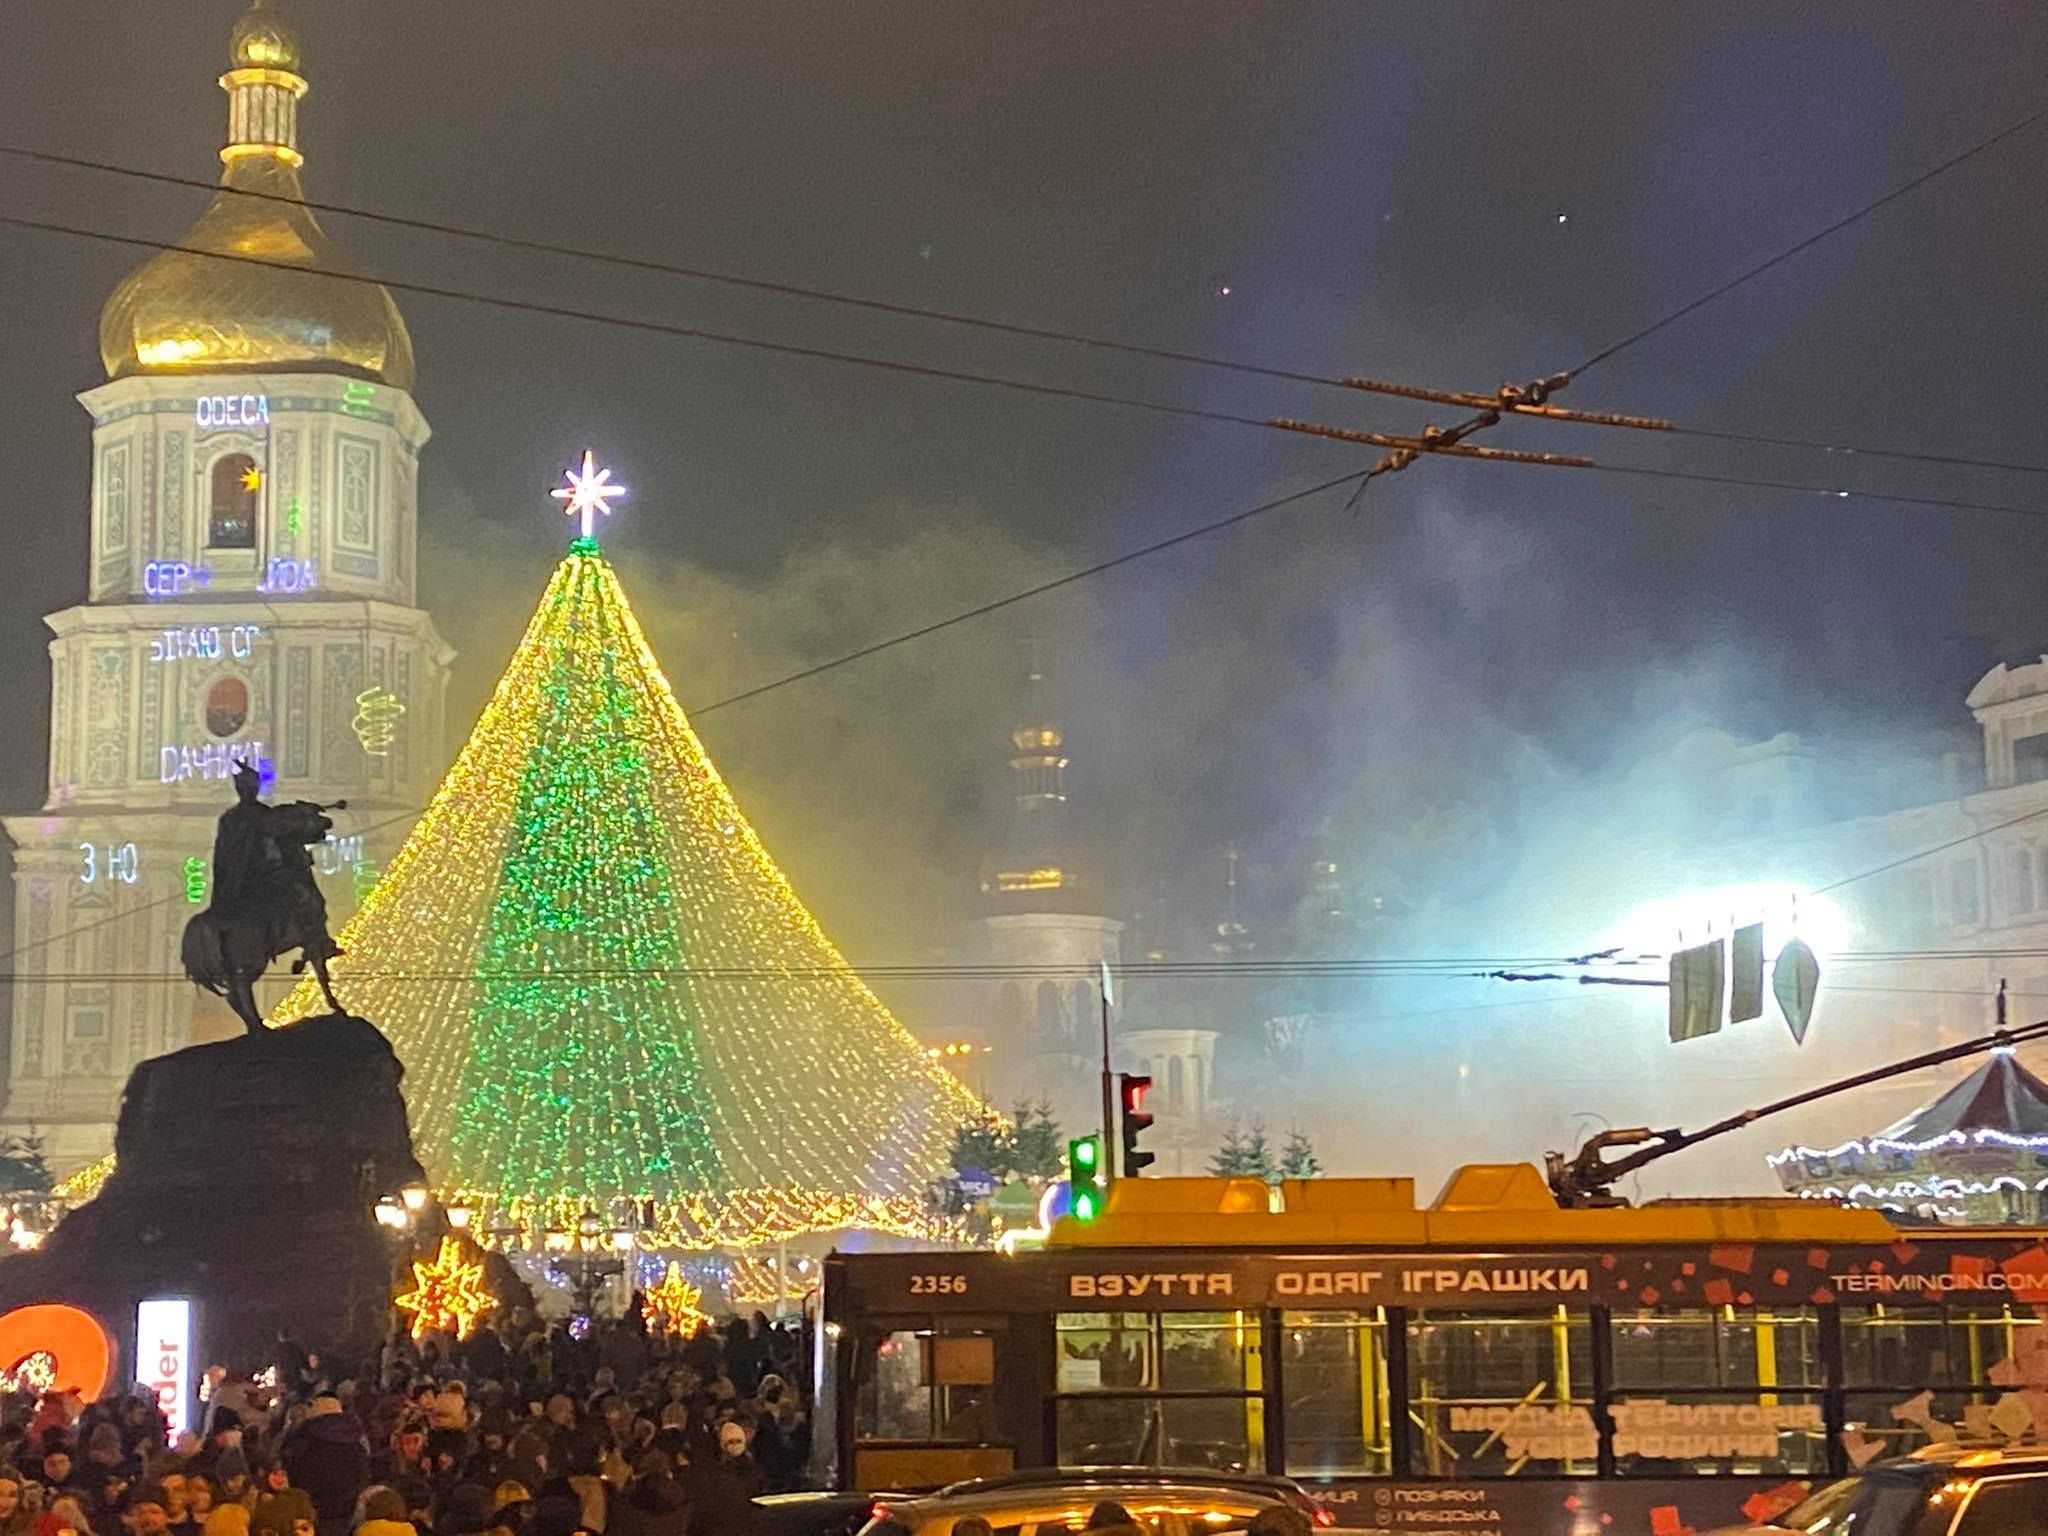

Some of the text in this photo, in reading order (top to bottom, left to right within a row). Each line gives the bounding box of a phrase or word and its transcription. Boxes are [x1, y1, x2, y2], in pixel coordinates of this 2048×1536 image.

[910, 1275, 967, 1293] 2356
[1070, 1273, 1233, 1297] ВЗУТТЯ
[1275, 1269, 1588, 1296] ОДЯГ ІГРАШКИ
